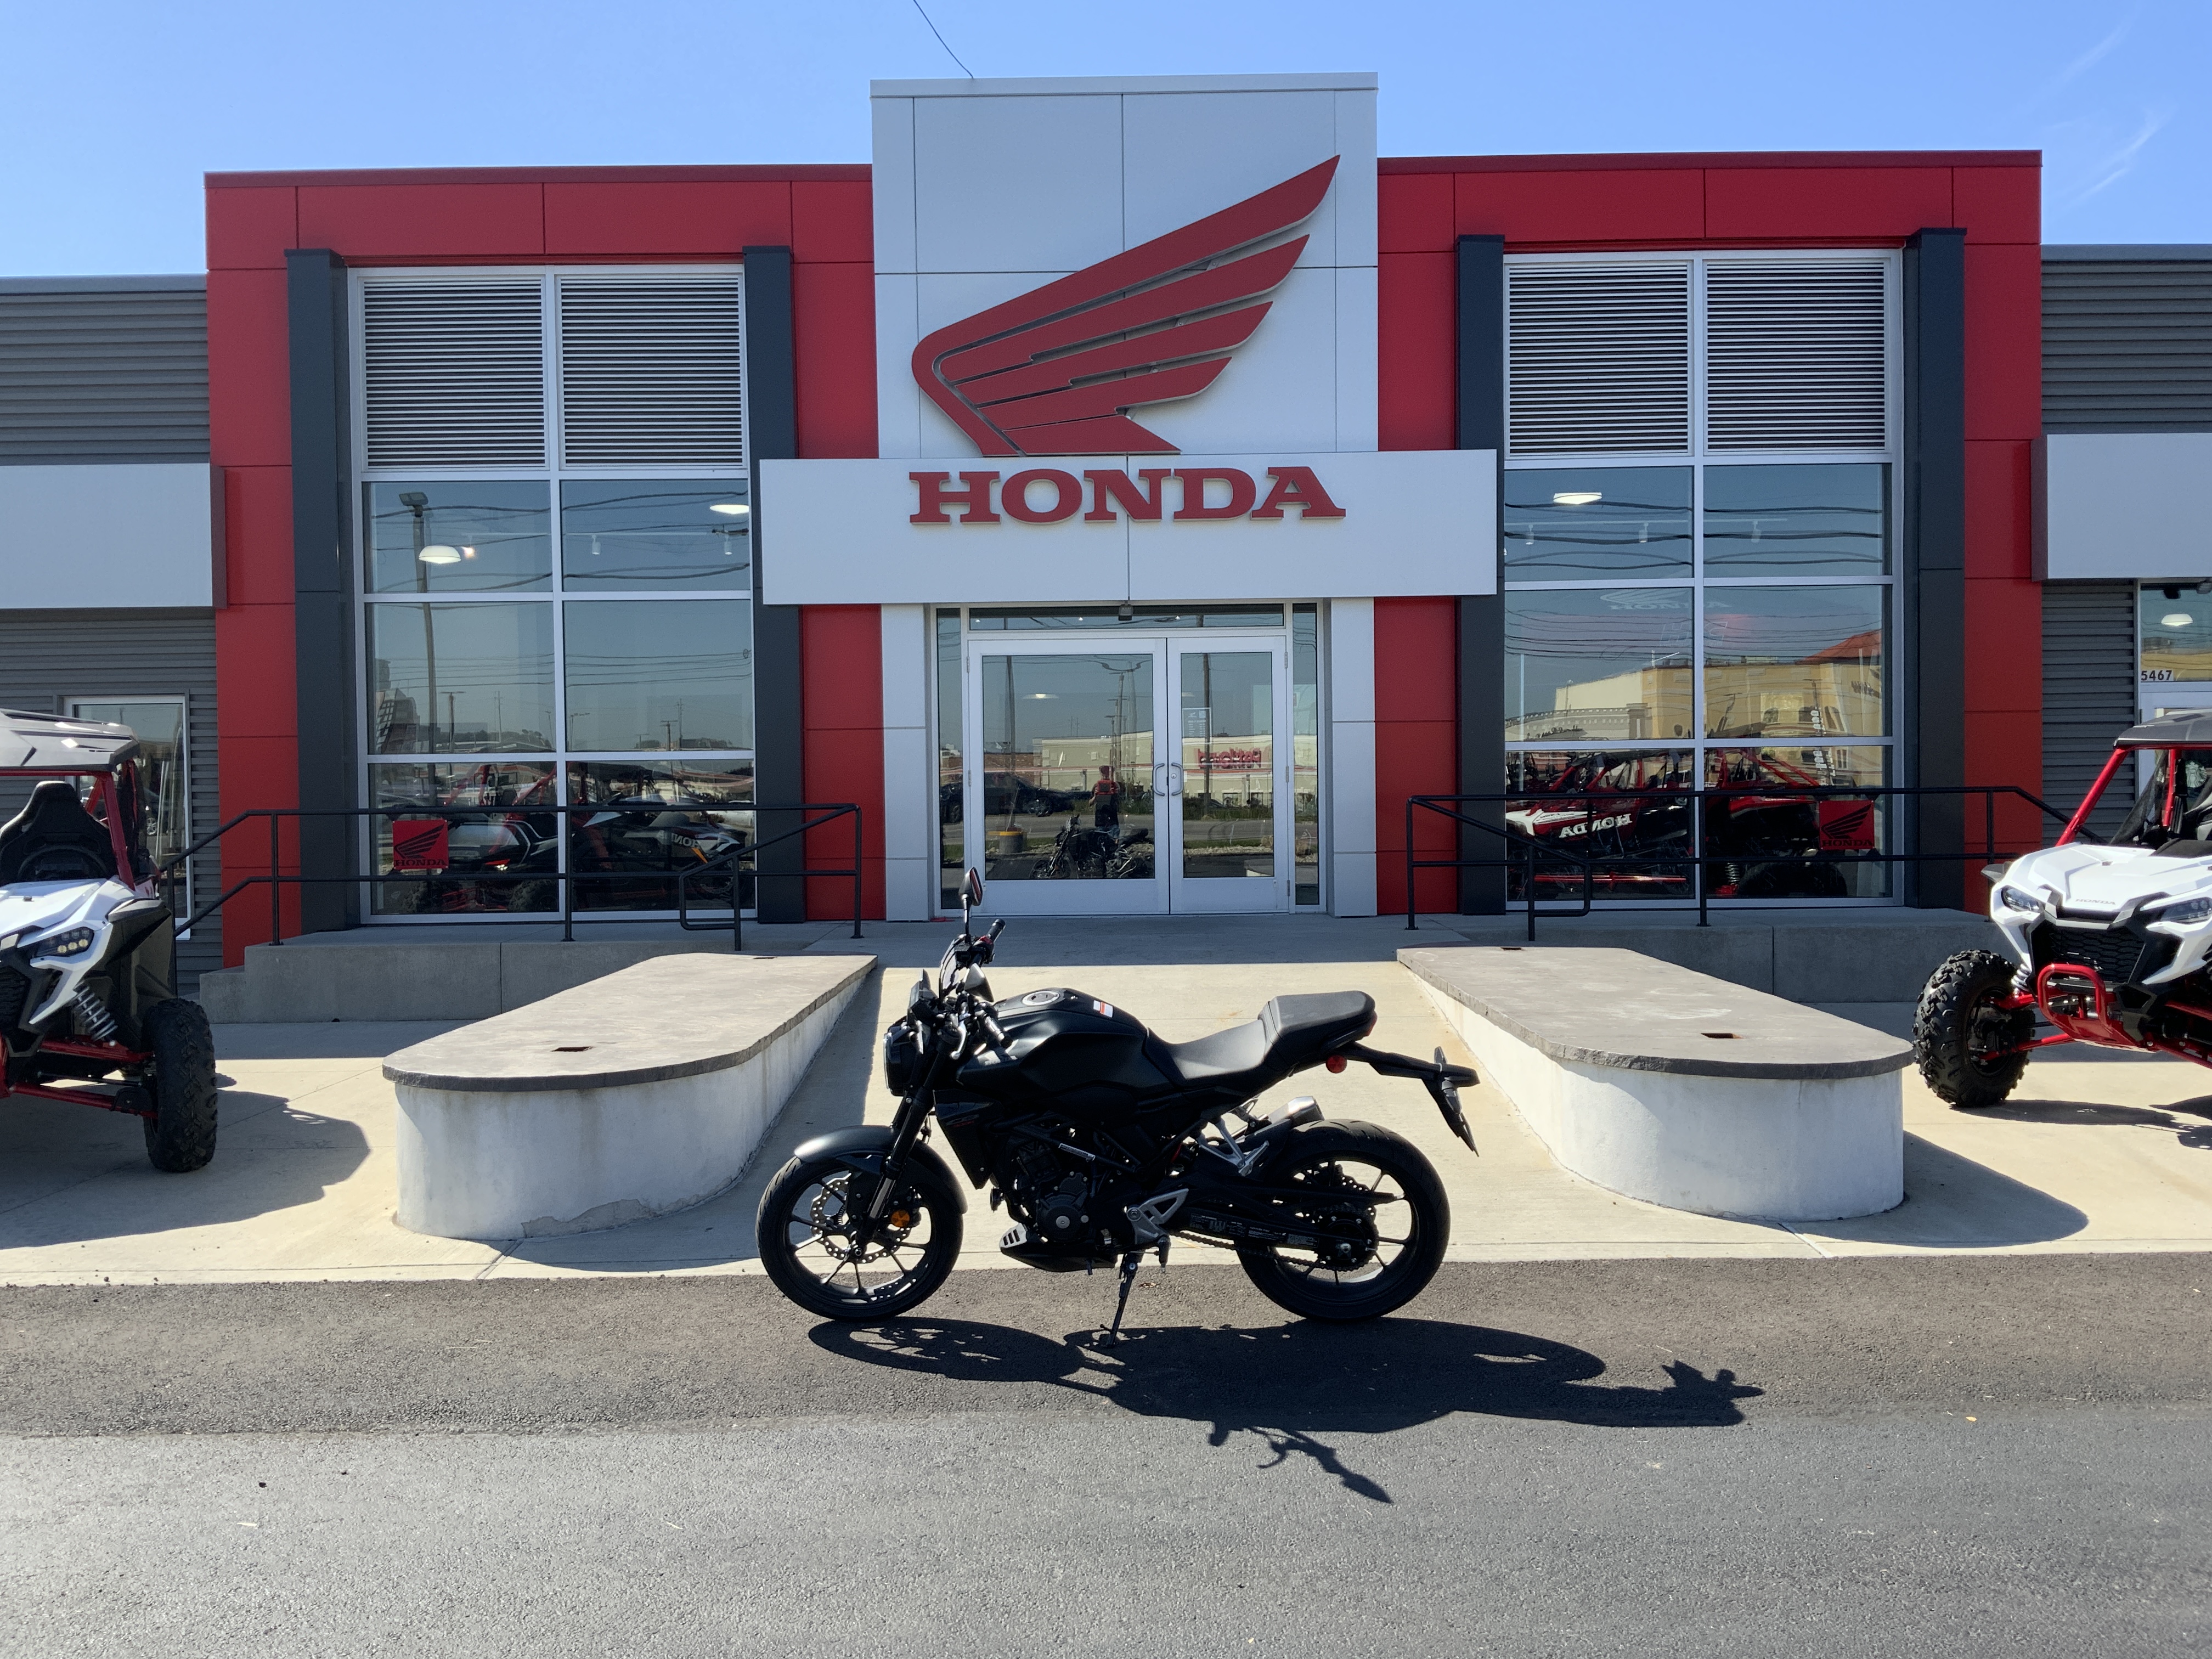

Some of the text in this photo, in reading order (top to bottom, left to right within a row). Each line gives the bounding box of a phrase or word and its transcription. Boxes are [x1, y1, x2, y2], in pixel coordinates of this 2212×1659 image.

[909, 466, 1346, 524] HONDA
[1608, 601, 1732, 610] HONA
[2141, 670, 2172, 681] 5467
